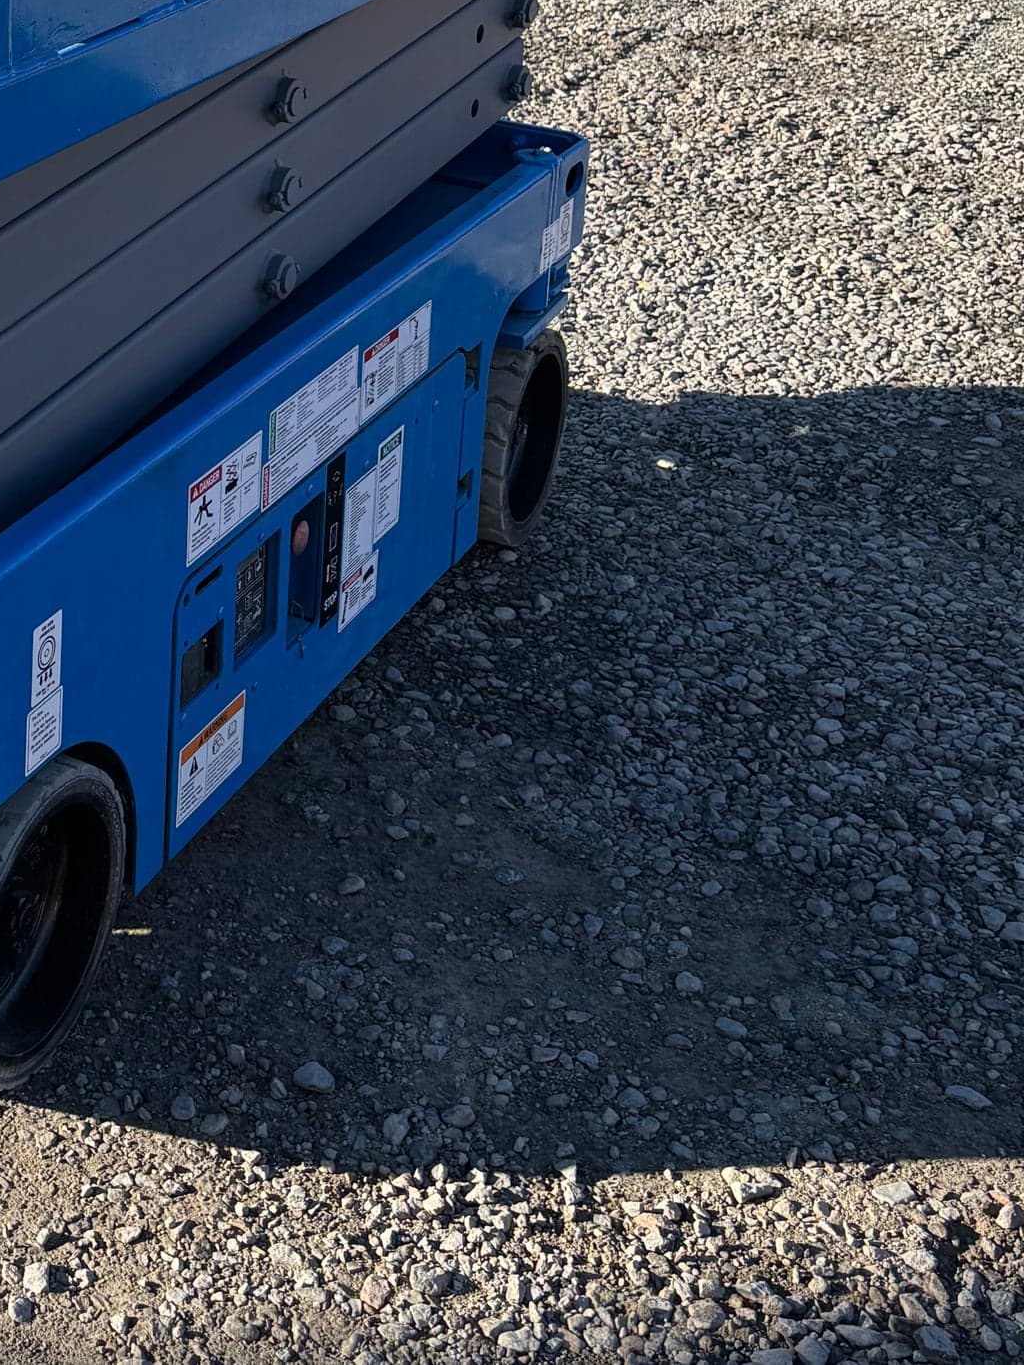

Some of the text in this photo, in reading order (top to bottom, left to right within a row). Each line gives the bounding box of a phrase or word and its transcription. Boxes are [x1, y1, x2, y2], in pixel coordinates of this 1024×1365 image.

[383, 434, 400, 456] NOTICE
[198, 469, 220, 493] DANGER
[324, 590, 338, 611] STOP
